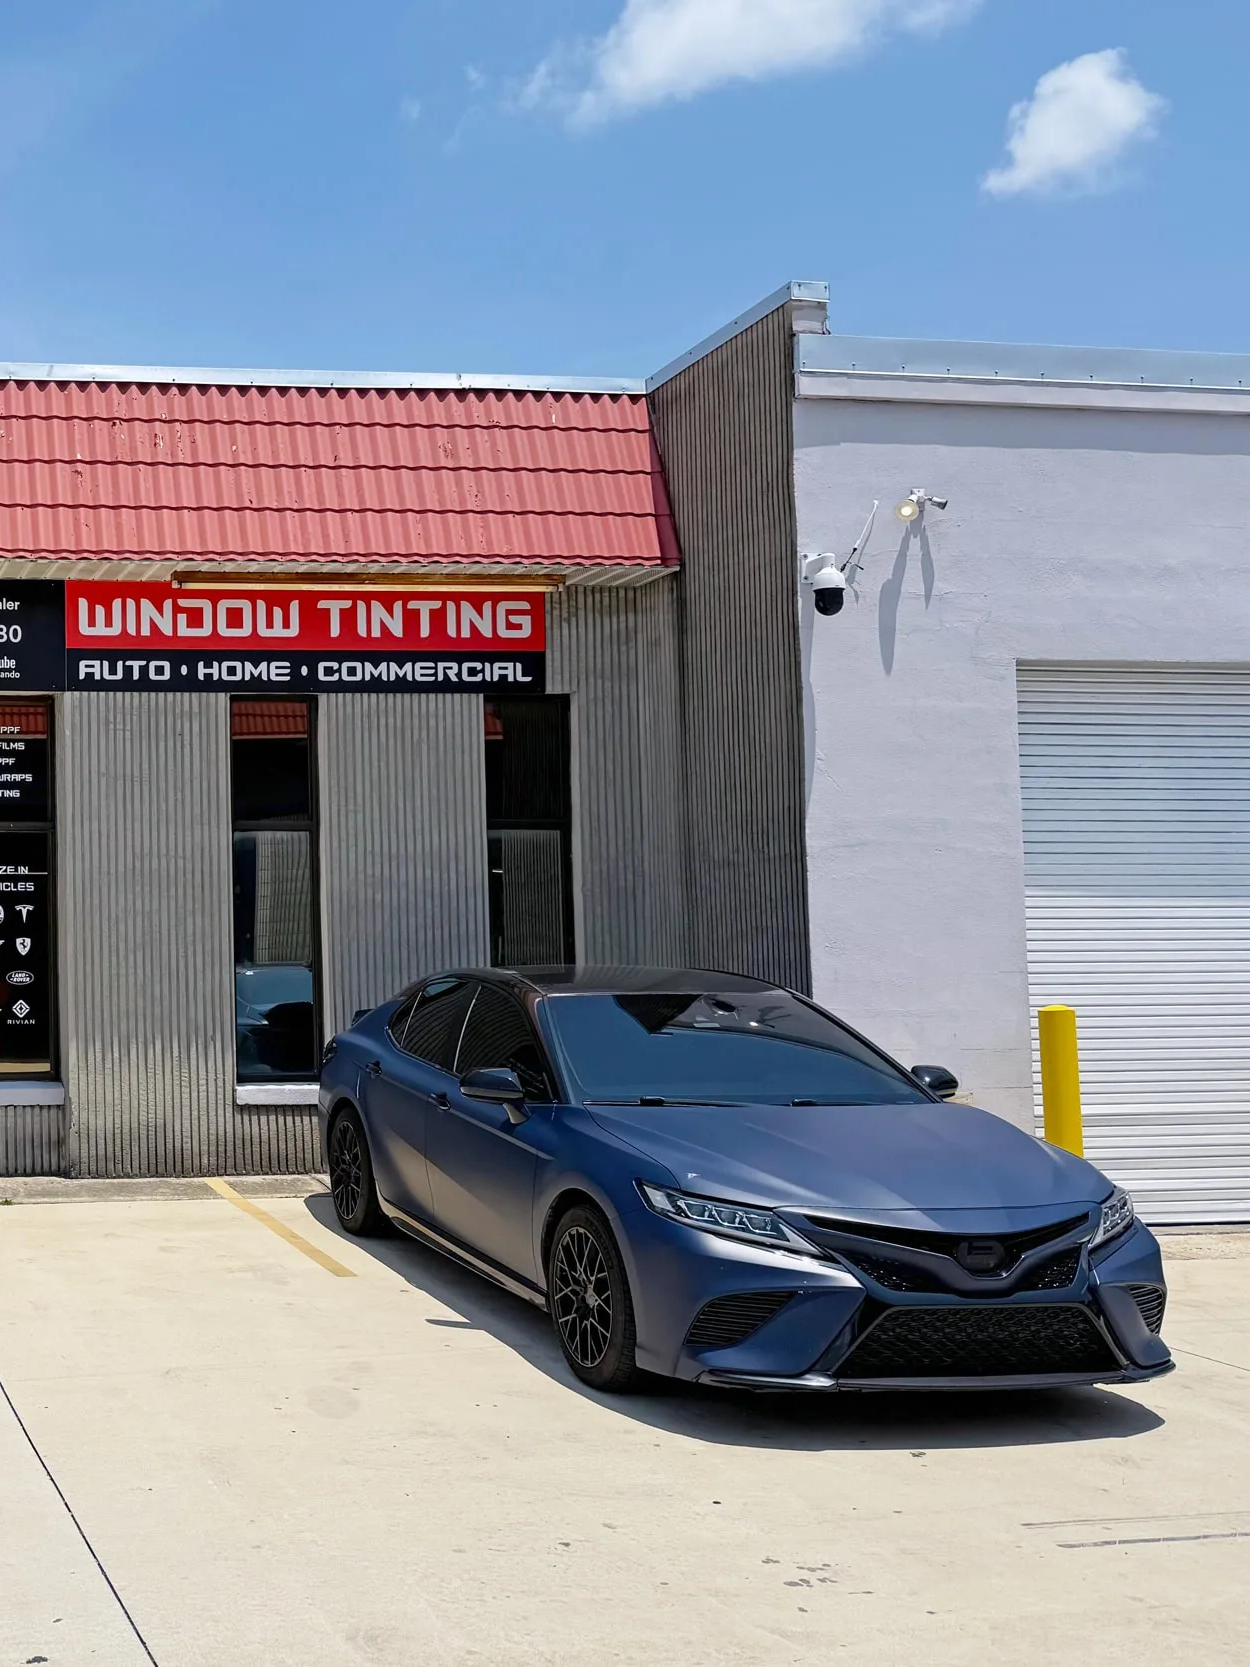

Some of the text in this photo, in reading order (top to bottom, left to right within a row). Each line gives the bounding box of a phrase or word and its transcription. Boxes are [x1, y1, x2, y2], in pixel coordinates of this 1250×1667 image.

[78, 597, 533, 639] WINDOW TINTING
[78, 660, 533, 682] AUTO HOME COMMERCIAL
[0, 726, 21, 734] PPF
